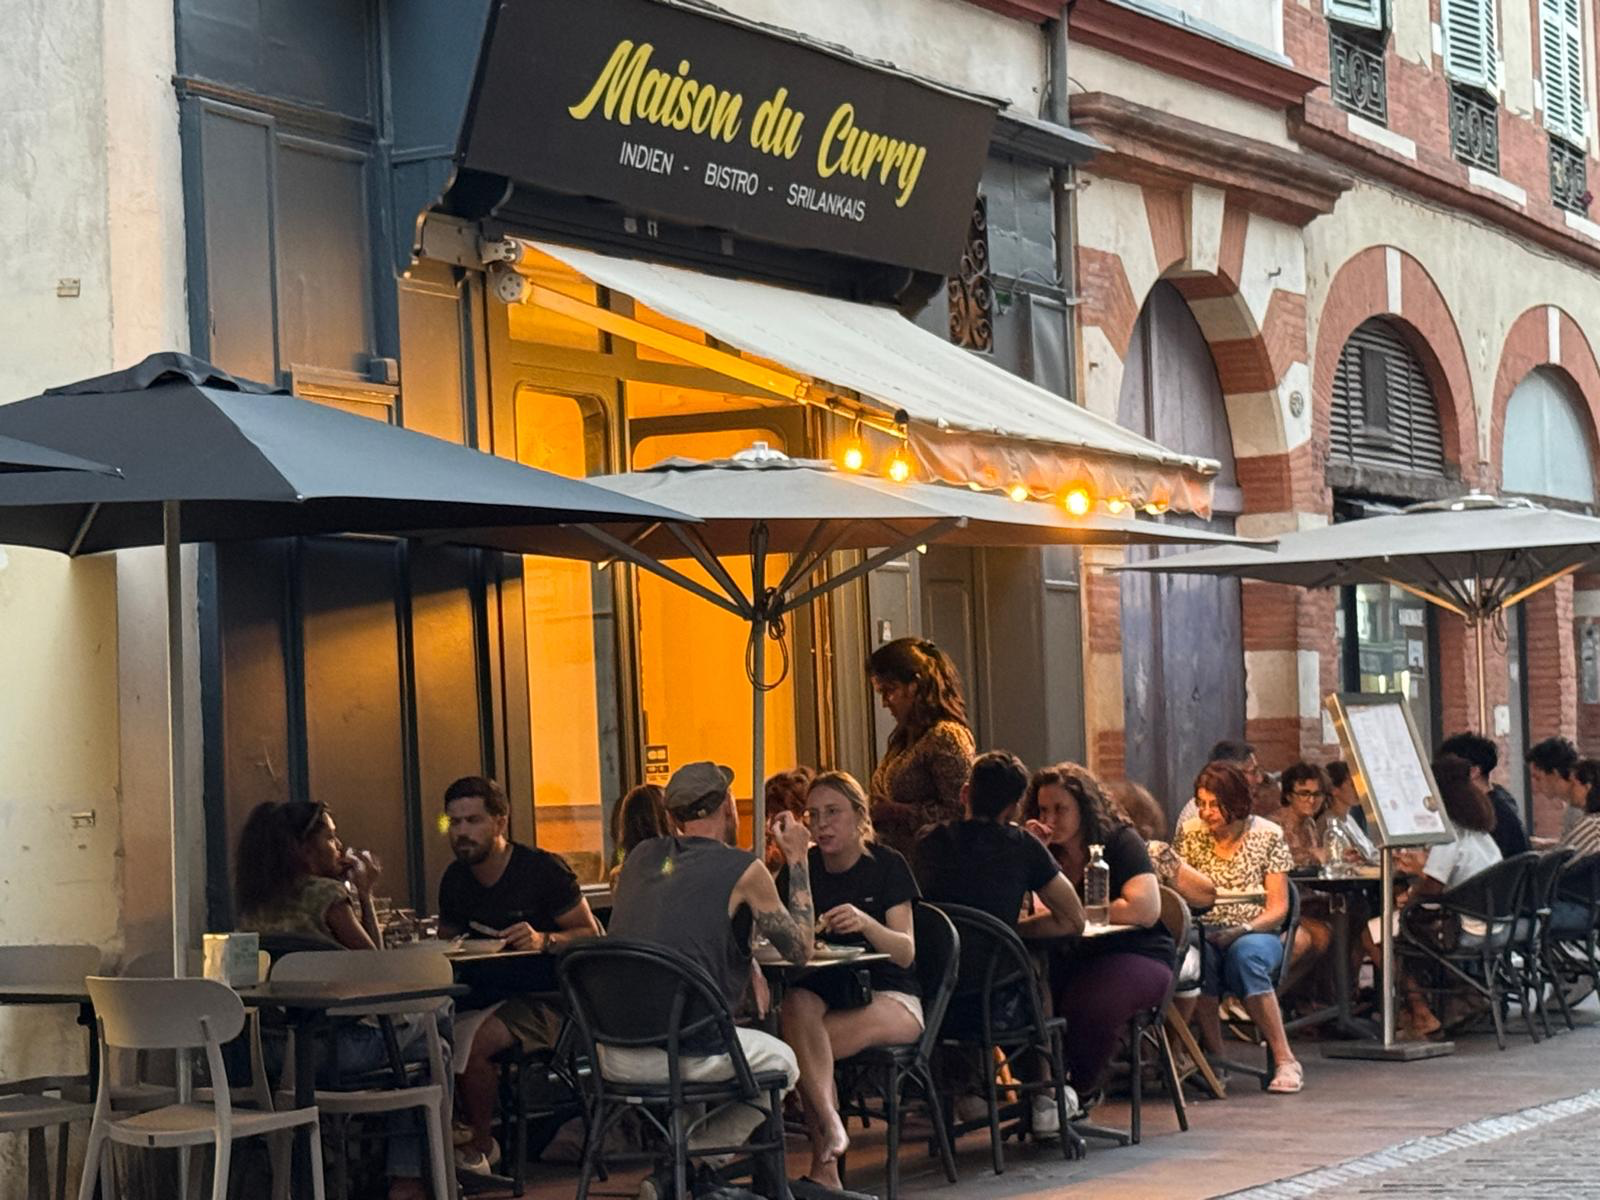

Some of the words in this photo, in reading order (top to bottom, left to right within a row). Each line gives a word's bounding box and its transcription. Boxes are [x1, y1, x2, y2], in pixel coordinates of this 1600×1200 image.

[569, 40, 743, 143] Maison
[751, 88, 804, 159] du
[816, 102, 926, 206] Curry
[619, 141, 674, 175] INDIEN
[704, 163, 759, 196] BISTRO
[786, 183, 866, 222] SRILANKAIS
